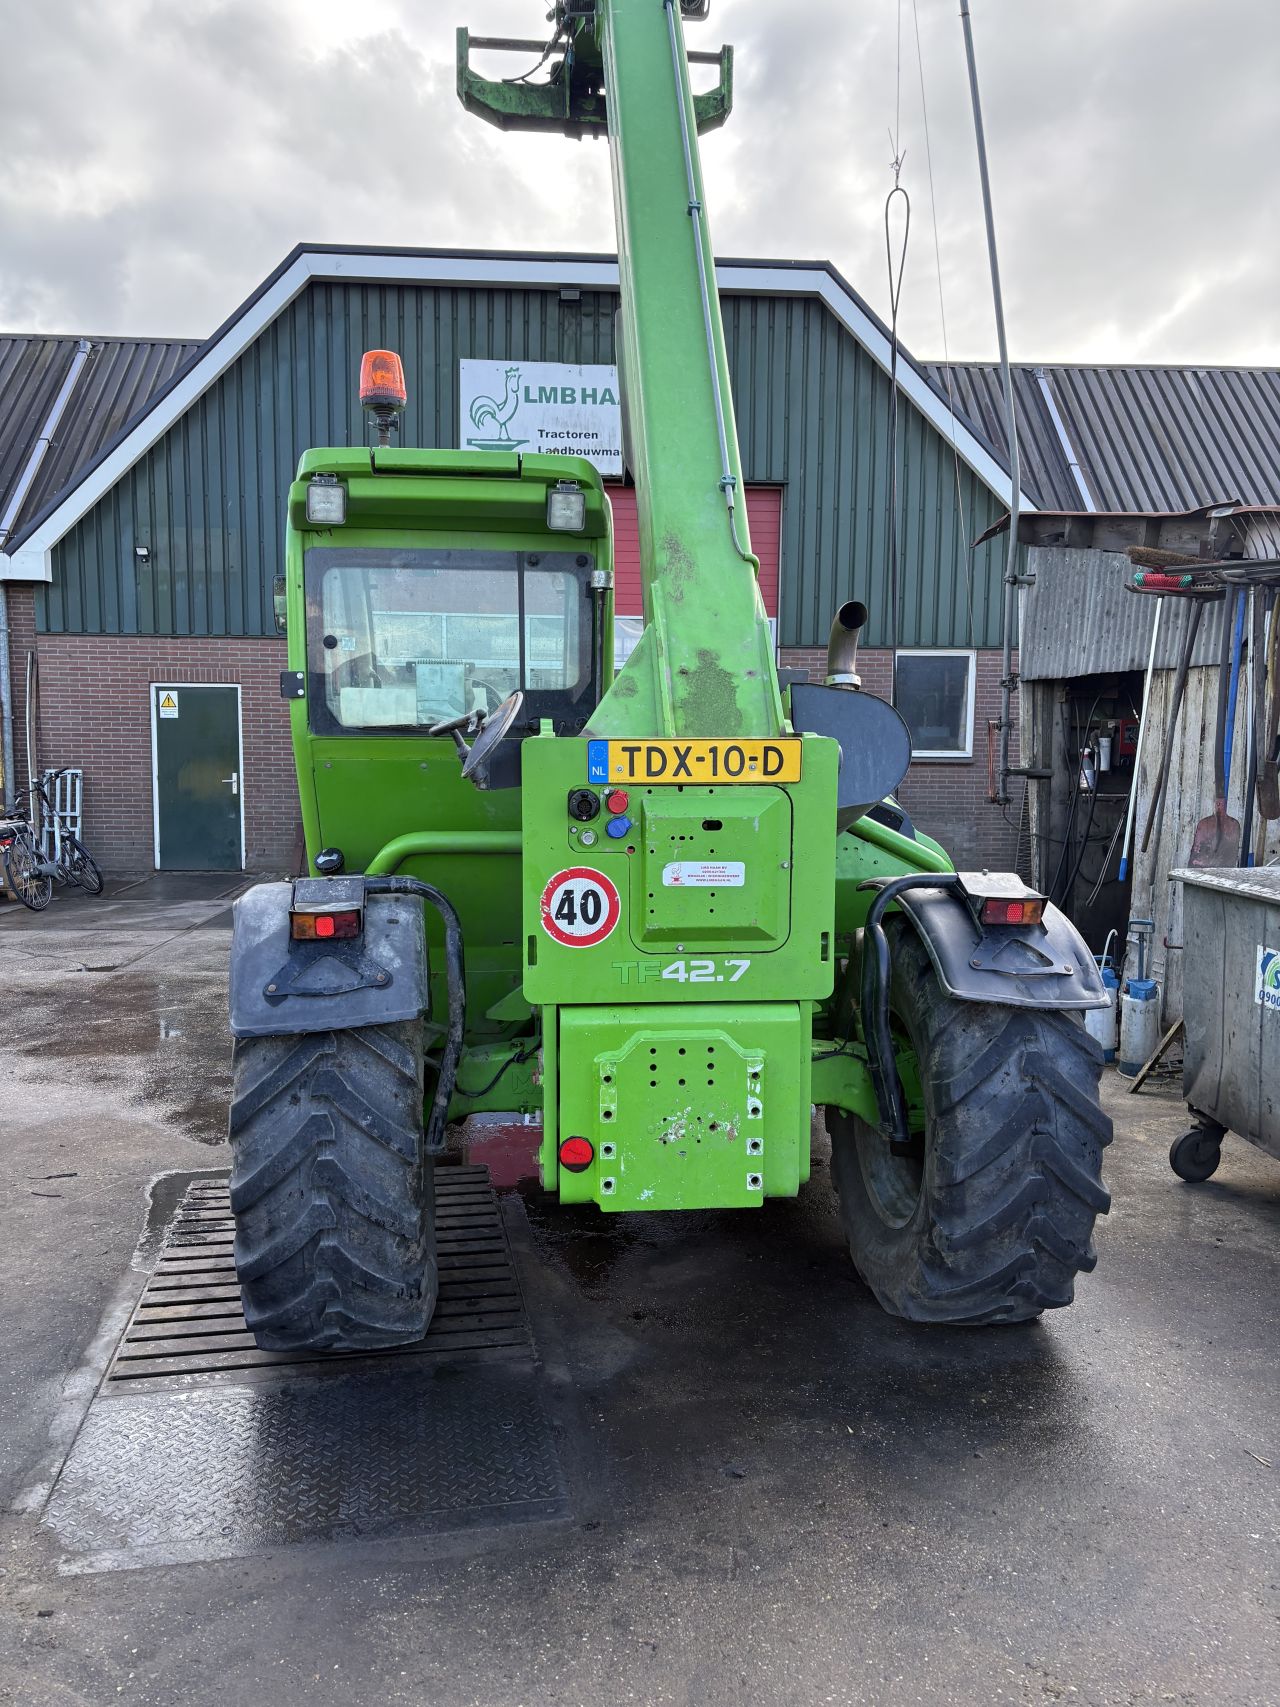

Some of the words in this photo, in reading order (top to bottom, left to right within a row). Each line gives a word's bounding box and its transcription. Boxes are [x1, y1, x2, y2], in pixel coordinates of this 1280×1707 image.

[523, 385, 576, 404] LMB
[581, 387, 620, 406] HA
[537, 429, 598, 440] Tractoren
[537, 445, 624, 456] Landbouwma
[621, 745, 784, 777] TDX-10-D
[591, 766, 606, 776] NL
[555, 889, 602, 926] 40
